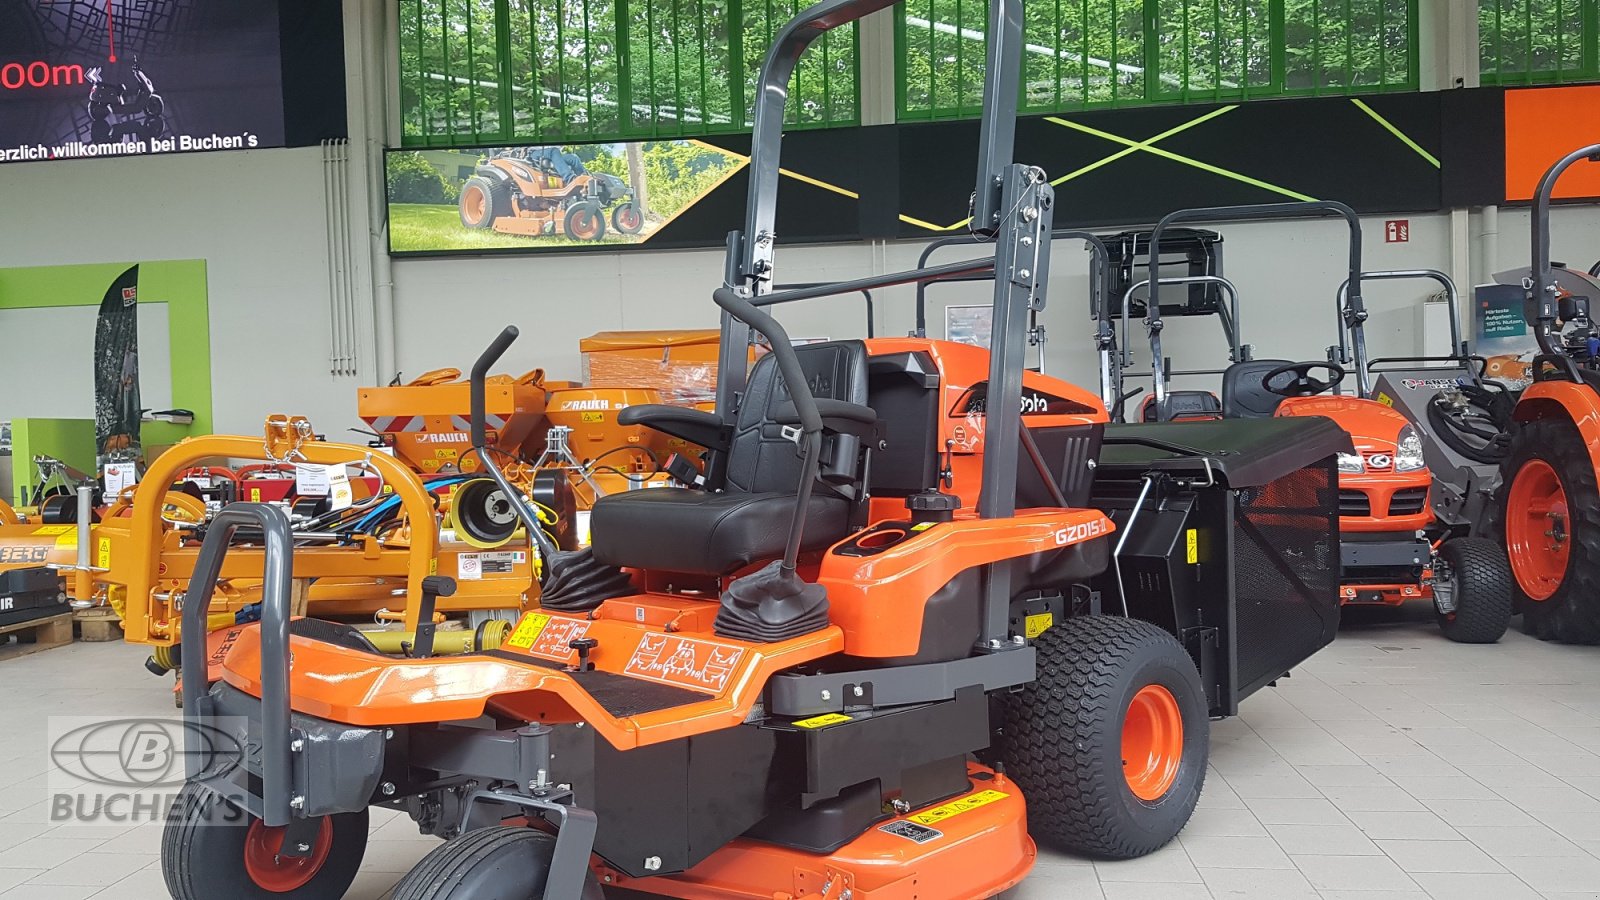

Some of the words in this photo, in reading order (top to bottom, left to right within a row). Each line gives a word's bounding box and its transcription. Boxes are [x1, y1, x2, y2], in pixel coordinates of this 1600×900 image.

[0, 61, 84, 89] 00m
[0, 144, 48, 161] erzlich
[51, 140, 146, 158] willkommen
[151, 136, 176, 151] bei
[572, 399, 609, 410] RAUCH
[429, 432, 469, 443] RAUCH
[0, 597, 14, 610] IR
